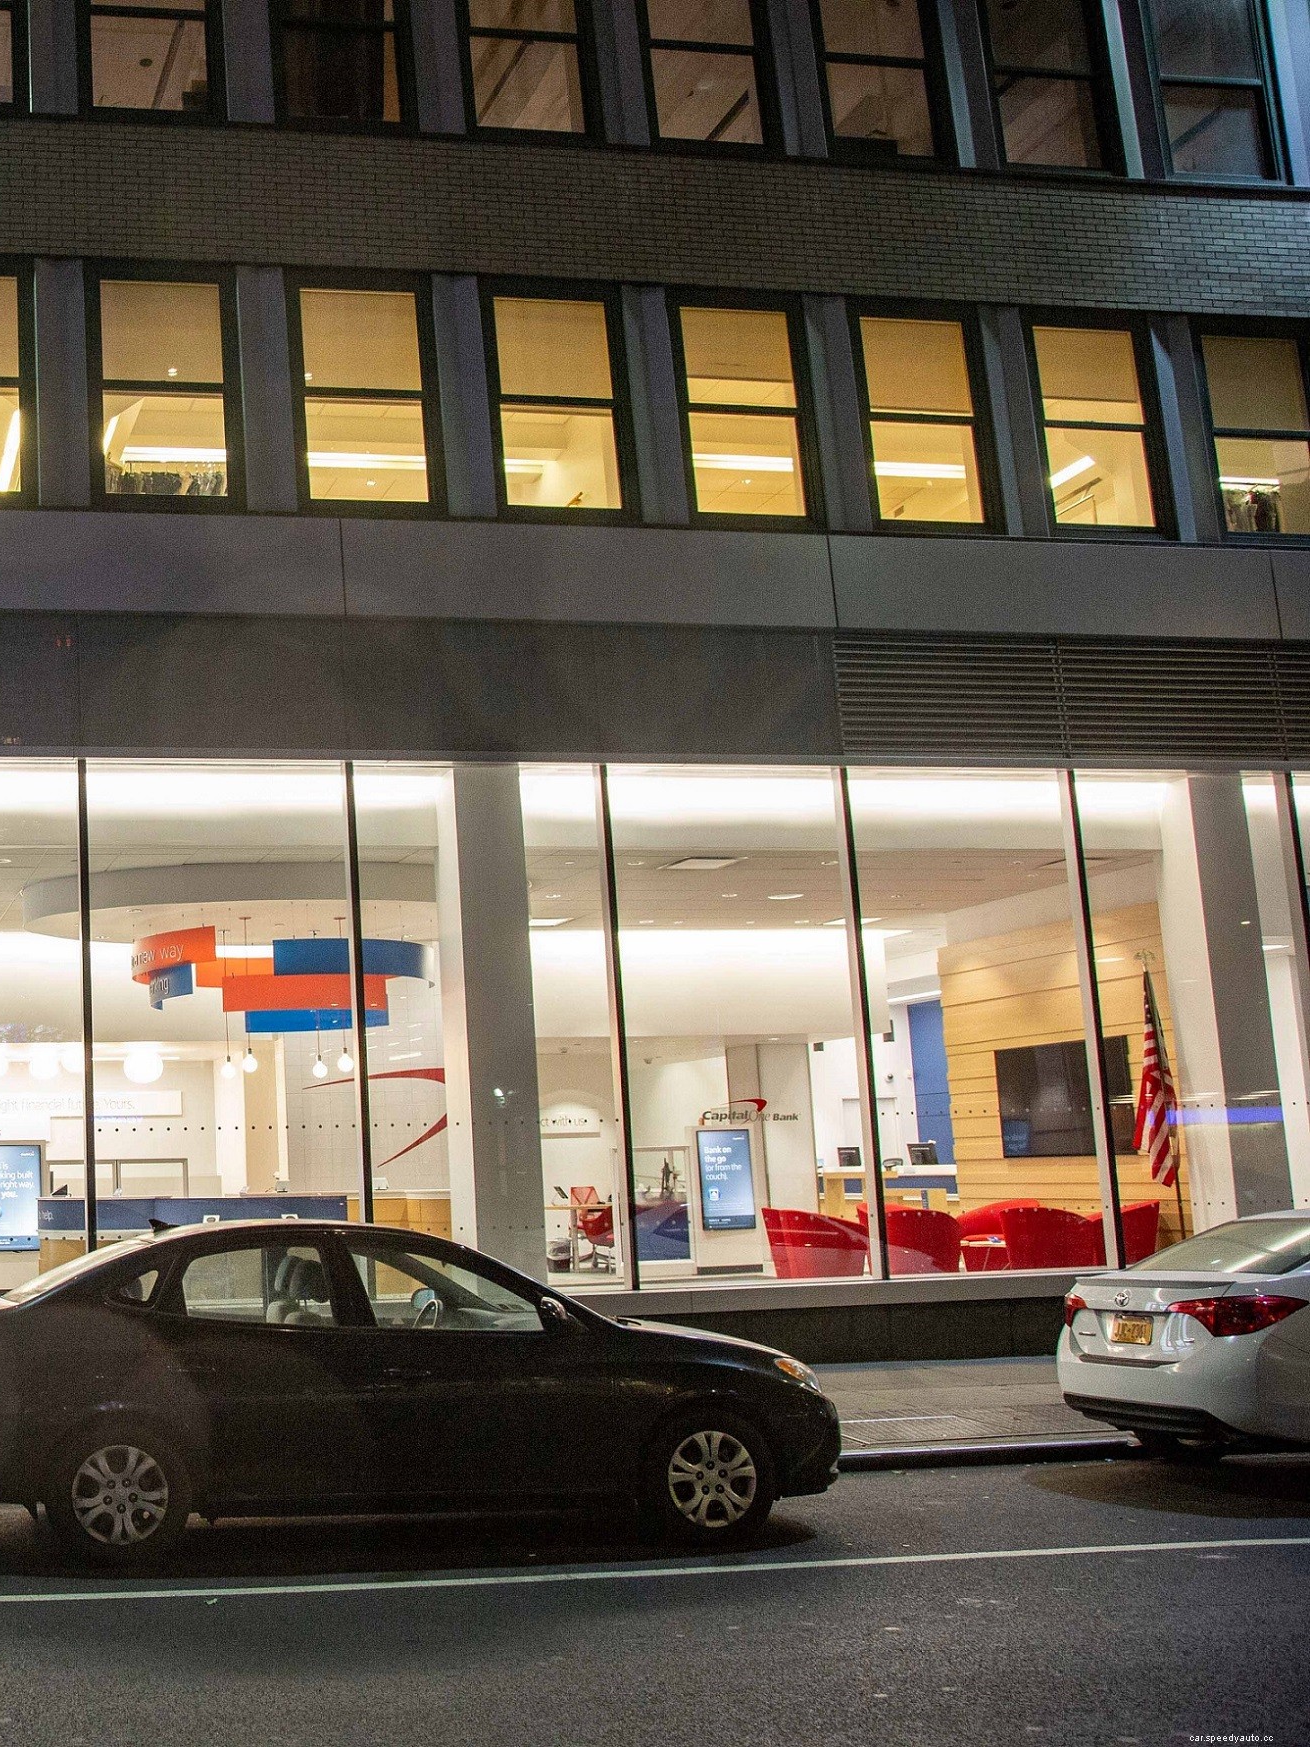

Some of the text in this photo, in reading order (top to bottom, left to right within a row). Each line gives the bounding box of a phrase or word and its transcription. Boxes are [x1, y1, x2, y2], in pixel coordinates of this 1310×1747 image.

[160, 944, 184, 962] way
[772, 1113, 799, 1122] Bank
[704, 1146, 721, 1154] Bank
[704, 1154, 727, 1164] the go
[17, 1170, 33, 1179] built
[0, 1180, 17, 1190] right
